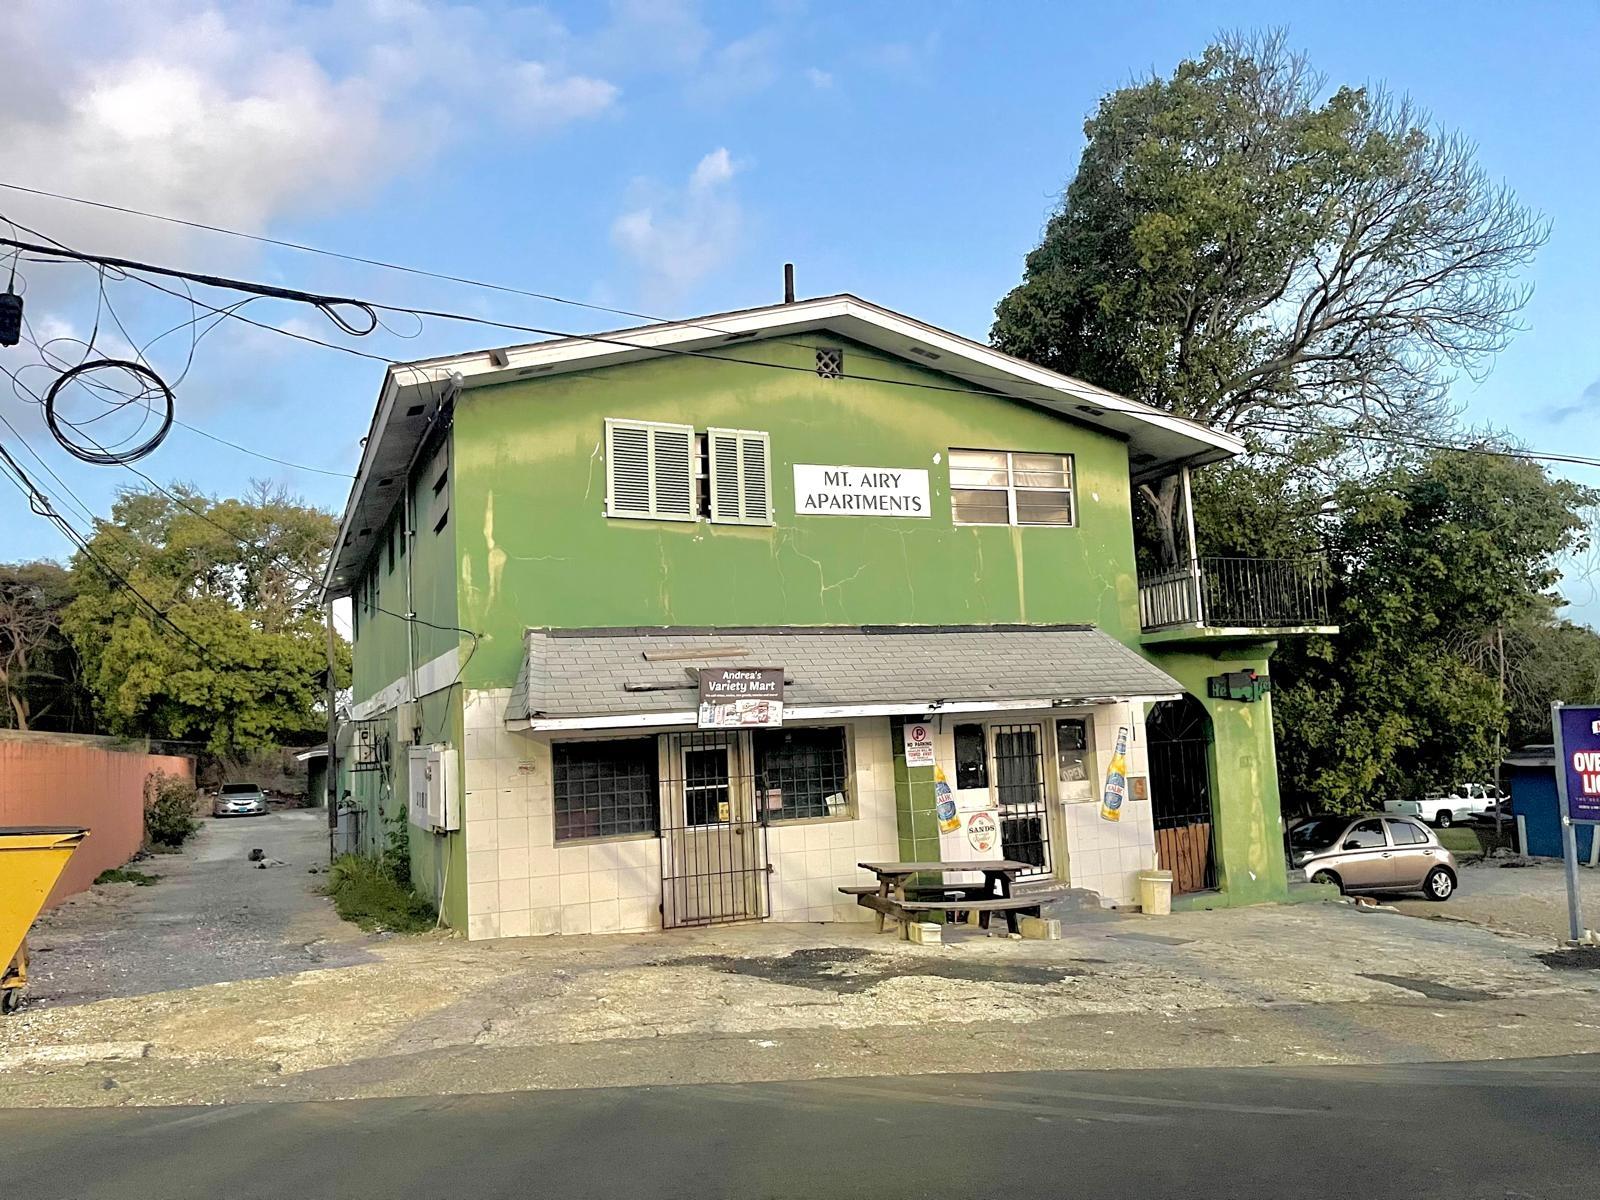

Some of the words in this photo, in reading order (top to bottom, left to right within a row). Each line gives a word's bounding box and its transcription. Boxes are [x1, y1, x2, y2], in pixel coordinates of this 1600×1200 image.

[824, 471, 852, 487] MT.
[860, 473, 902, 488] AIRY
[805, 493, 922, 511] APARTMENTS
[722, 671, 762, 680] Andrea's
[708, 680, 747, 693] Variety
[749, 681, 776, 691] Mart
[1062, 767, 1085, 781] OPEN
[968, 825, 995, 834] SANDS
